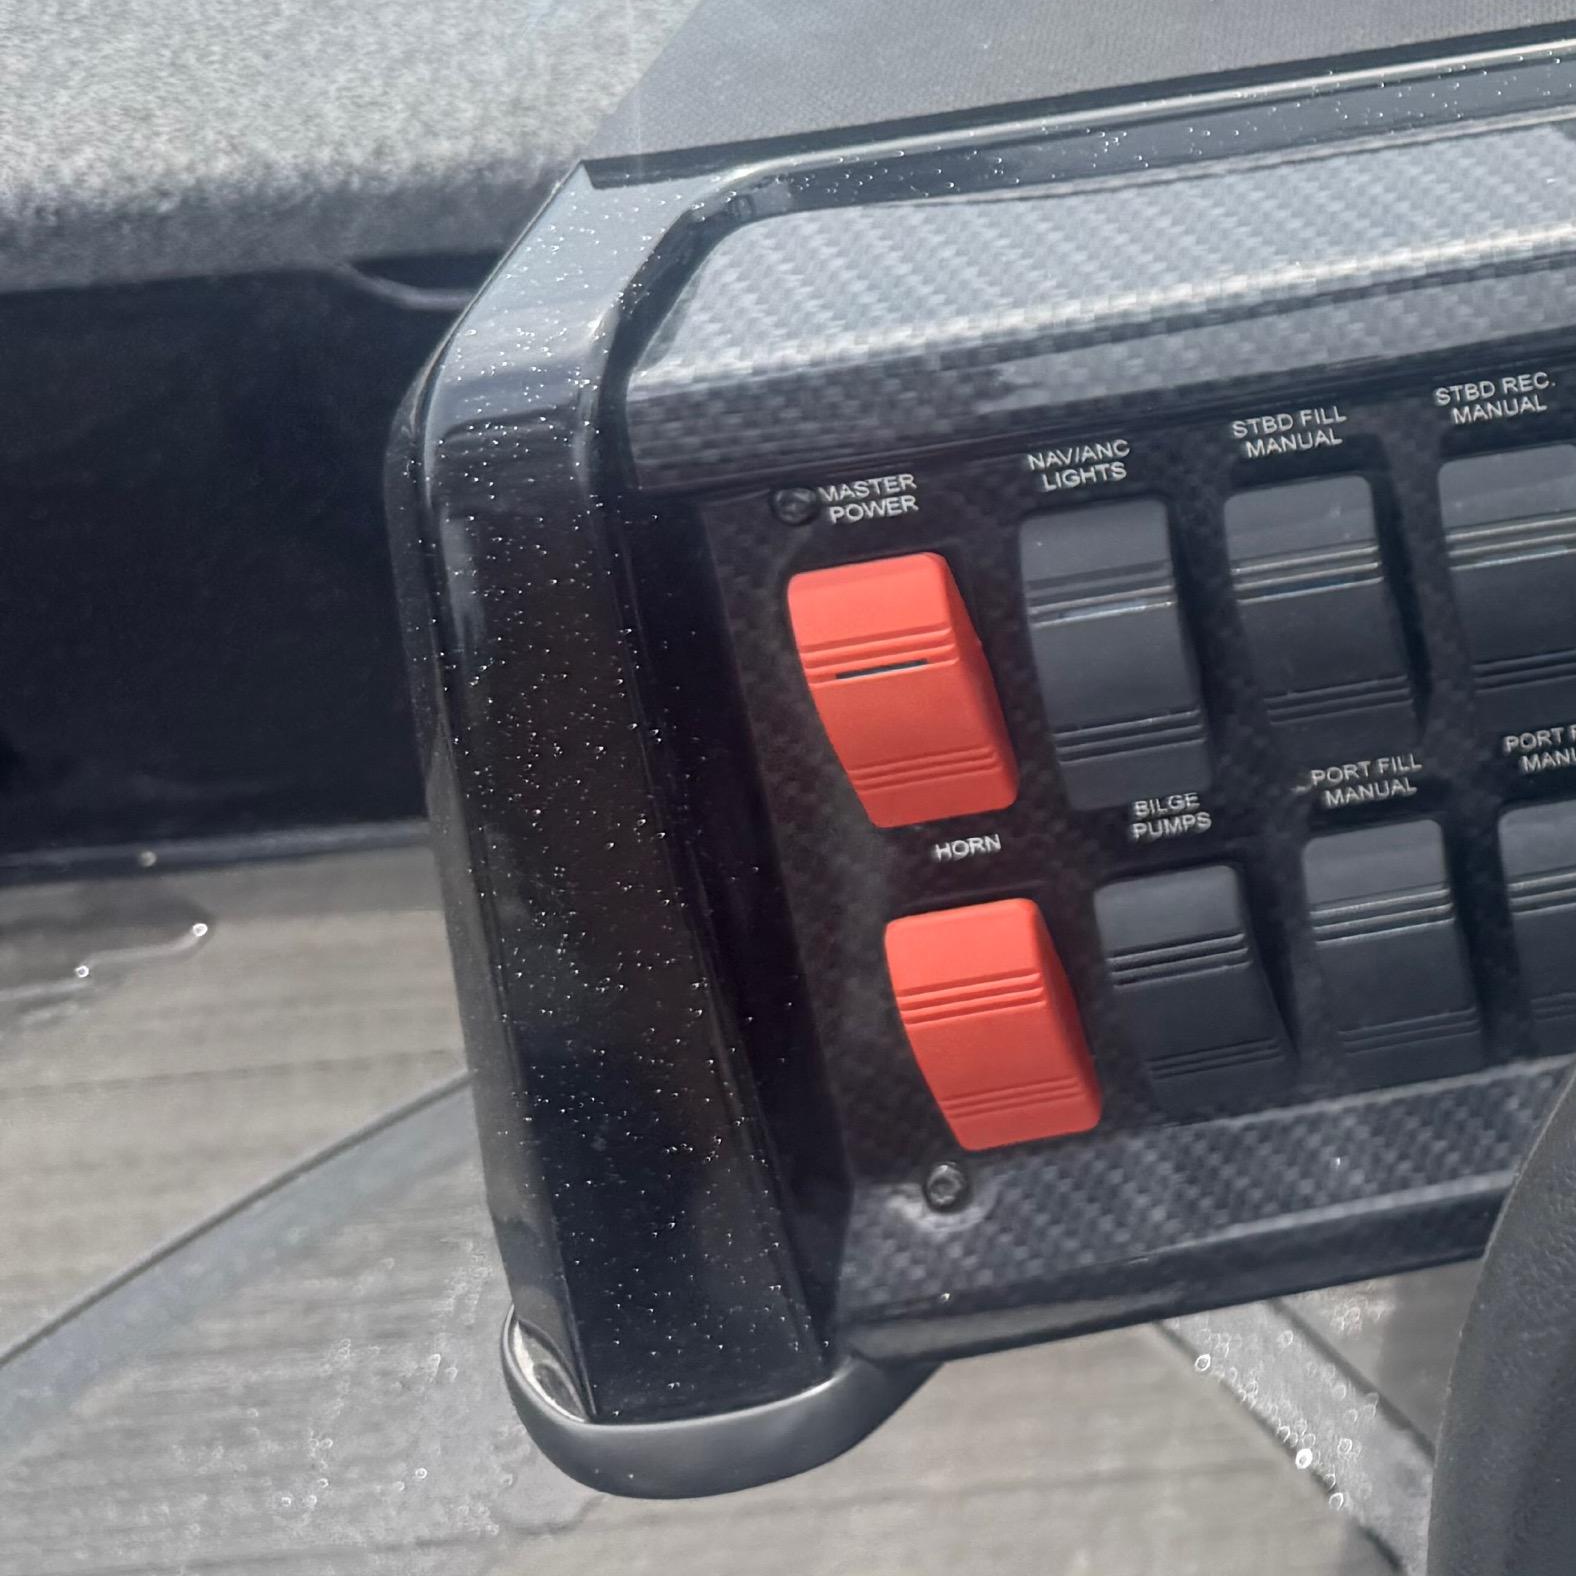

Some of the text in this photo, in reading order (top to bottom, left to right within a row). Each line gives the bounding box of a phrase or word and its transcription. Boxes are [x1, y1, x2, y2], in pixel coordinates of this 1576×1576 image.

[1434, 370, 1556, 406] STBD REC.
[1231, 405, 1347, 440] STBD FILL
[1451, 394, 1548, 425] MANUAL
[1026, 439, 1131, 472] NAV/ANC
[1244, 426, 1344, 460] MANUAL
[817, 473, 918, 504] MASTER
[1041, 461, 1128, 492] LIGHTS
[829, 493, 919, 524] POWER
[1502, 727, 1565, 755] PORT
[1310, 752, 1423, 787] PORT FILL
[1133, 791, 1201, 820] BILGE
[1324, 776, 1418, 809] MANUAL
[1130, 810, 1213, 843] PUMPS
[933, 833, 1002, 863] HORN
